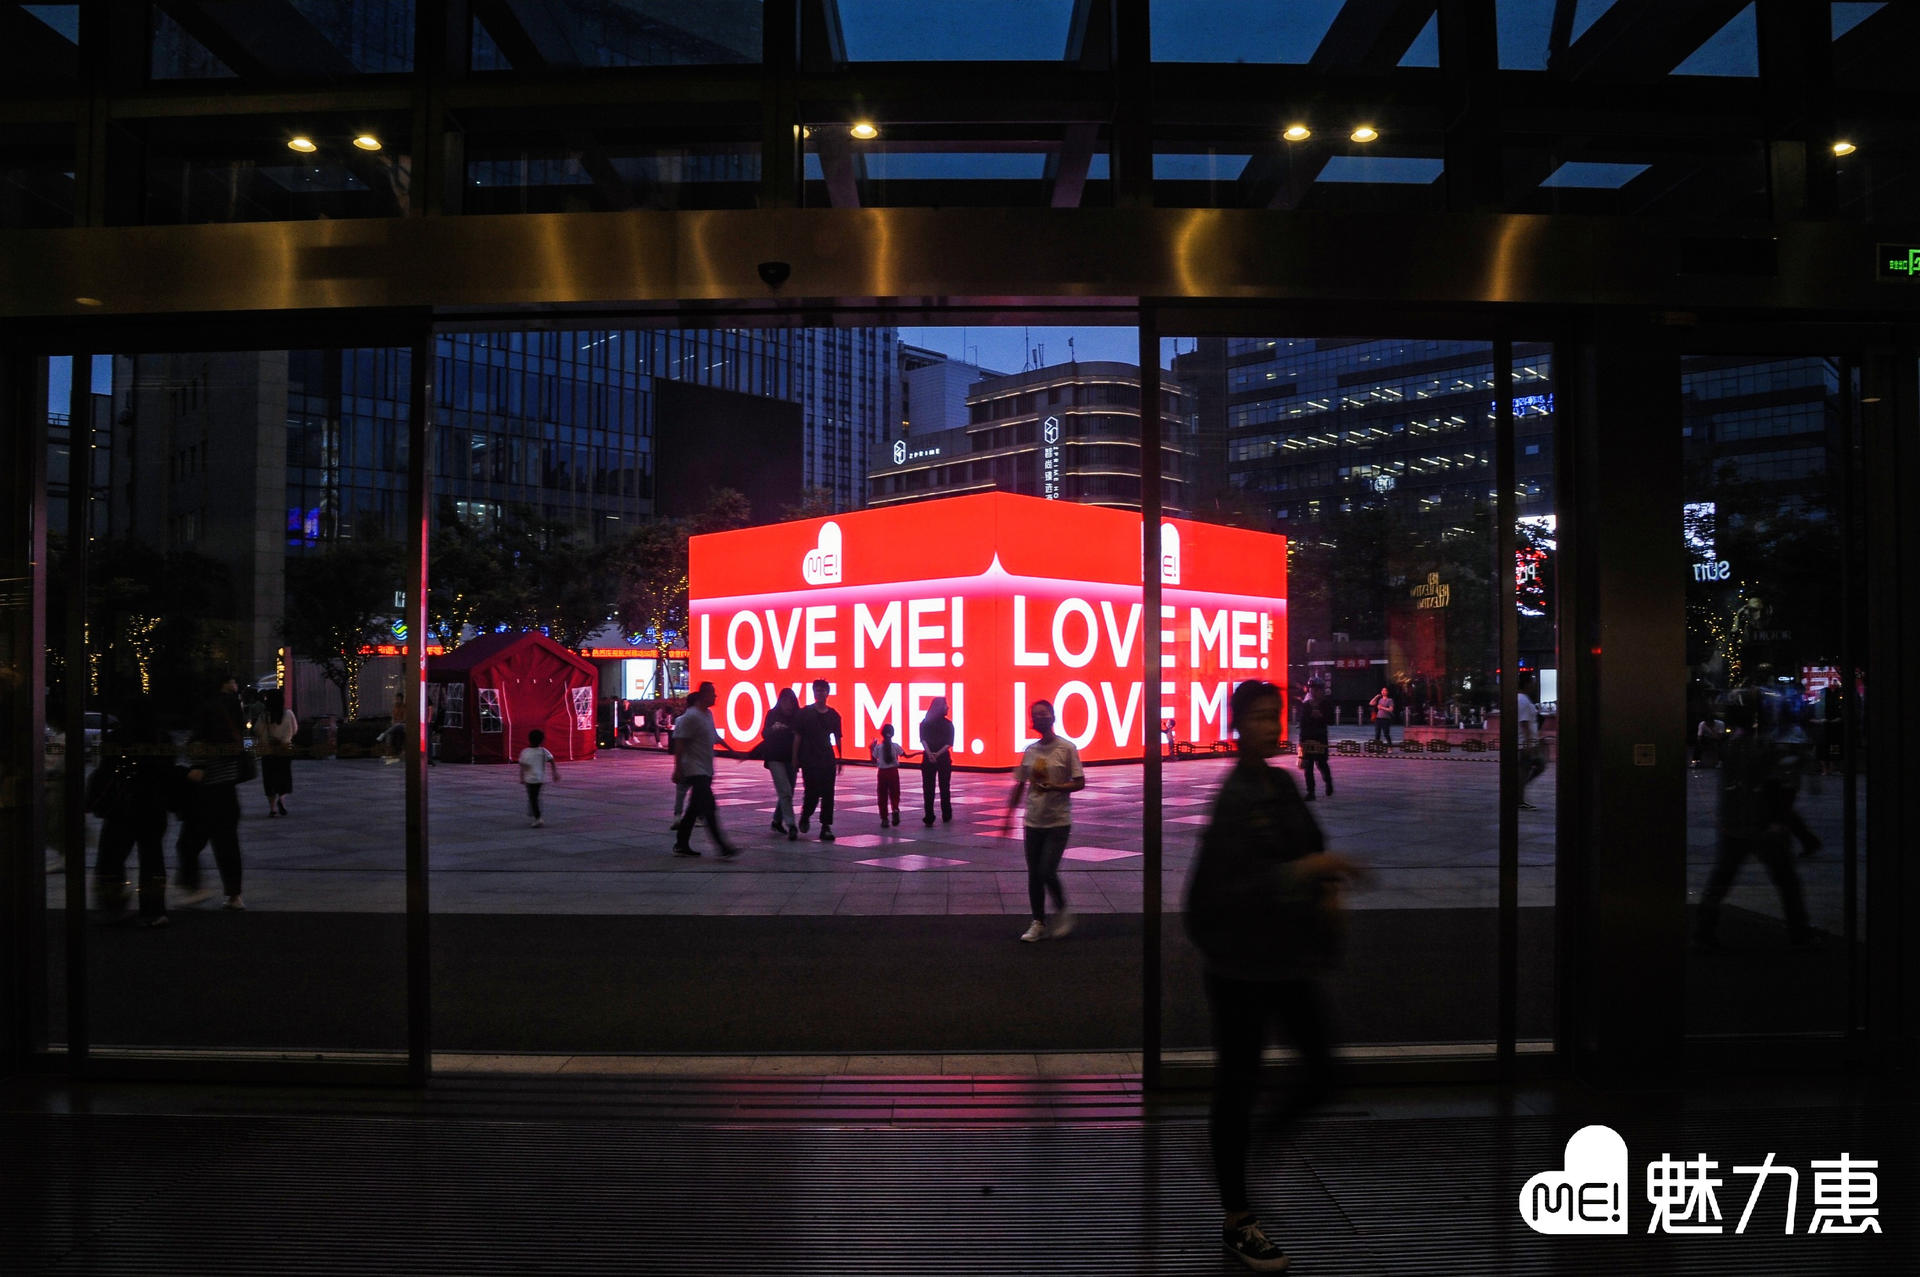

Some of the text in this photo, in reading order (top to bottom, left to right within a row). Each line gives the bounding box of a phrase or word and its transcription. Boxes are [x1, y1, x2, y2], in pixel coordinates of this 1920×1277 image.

[807, 554, 838, 578] ME!
[700, 596, 964, 671] LOVE ME!
[1191, 607, 1269, 669] ME!
